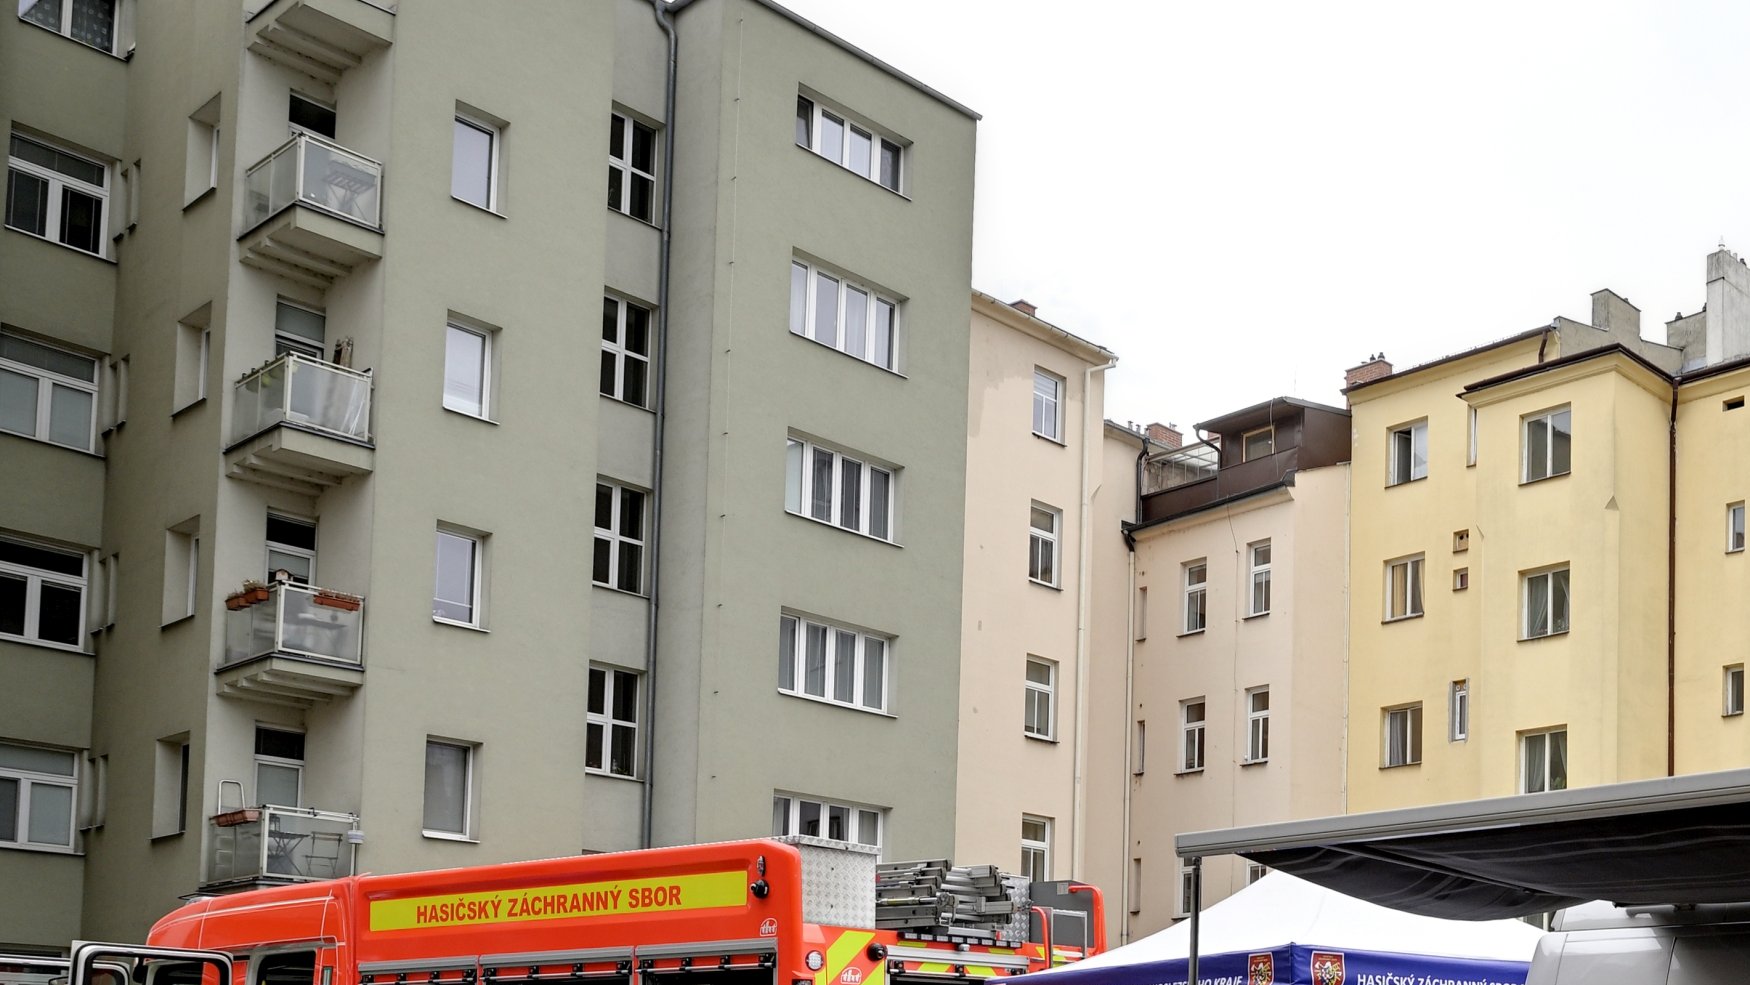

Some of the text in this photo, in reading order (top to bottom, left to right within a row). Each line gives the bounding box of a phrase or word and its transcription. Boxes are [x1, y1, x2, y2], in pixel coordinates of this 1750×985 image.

[416, 884, 682, 924] HASIČSKÝ ZÁCHRANNÝ SBOR
